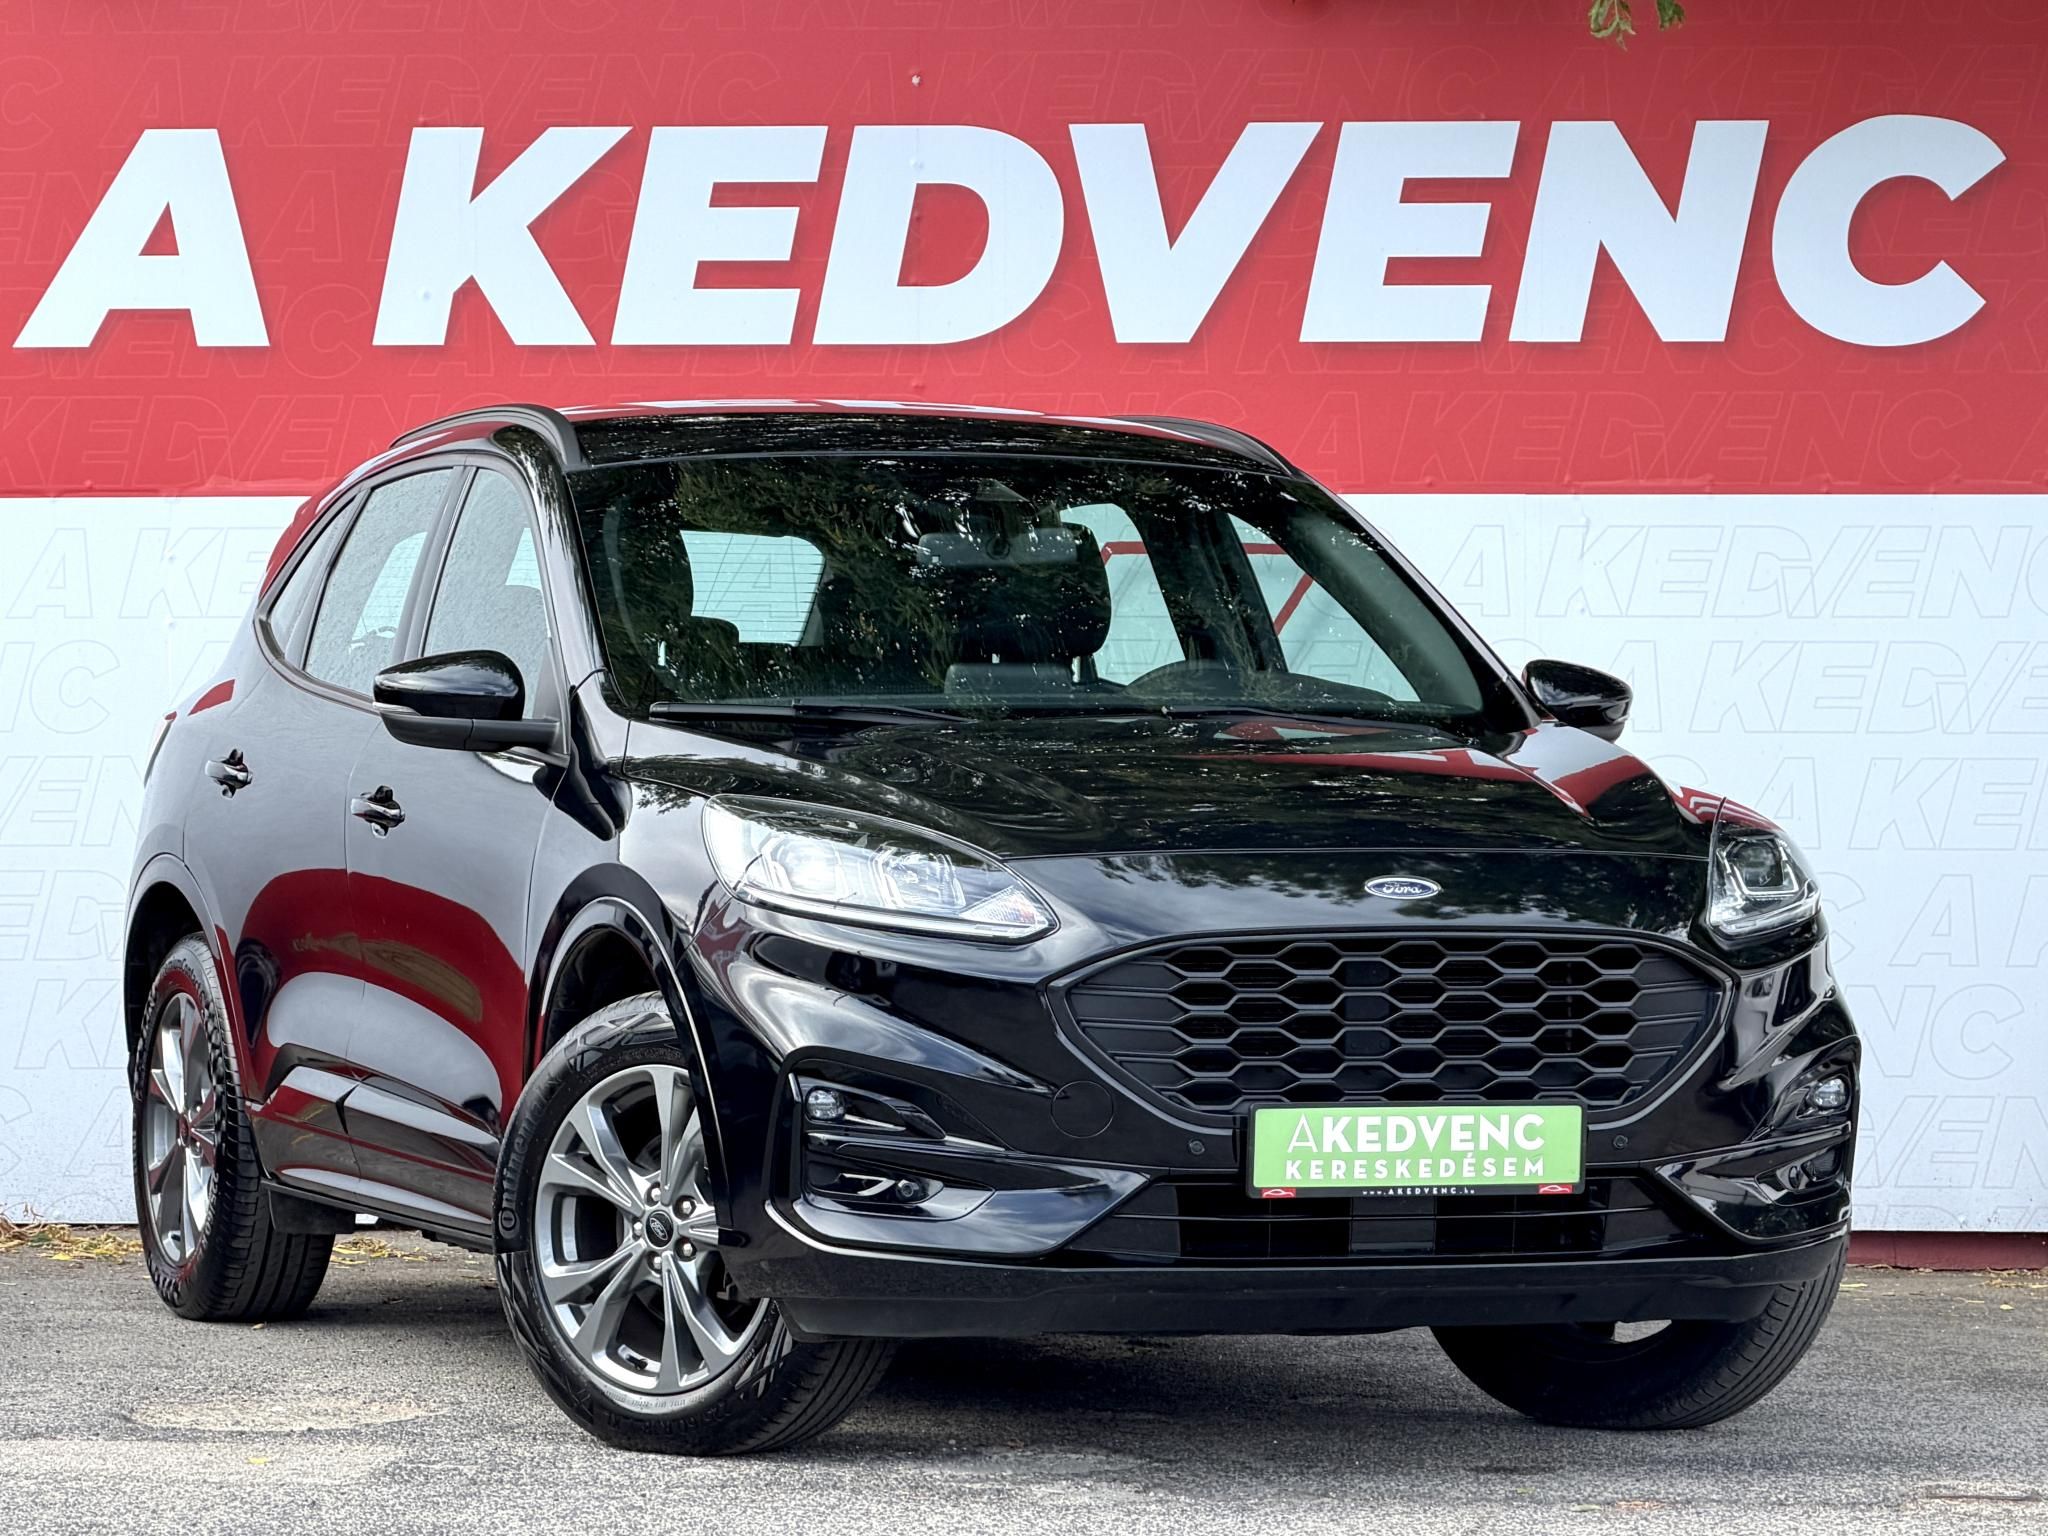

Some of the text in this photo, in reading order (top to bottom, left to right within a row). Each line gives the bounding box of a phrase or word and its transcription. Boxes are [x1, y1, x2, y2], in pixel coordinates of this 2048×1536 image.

[13, 129, 269, 348] A
[373, 115, 2006, 346] KEDVENC
[1534, 524, 2048, 620] KEDVEN
[1285, 1151, 1545, 1180] KERESKEDÉSEM
